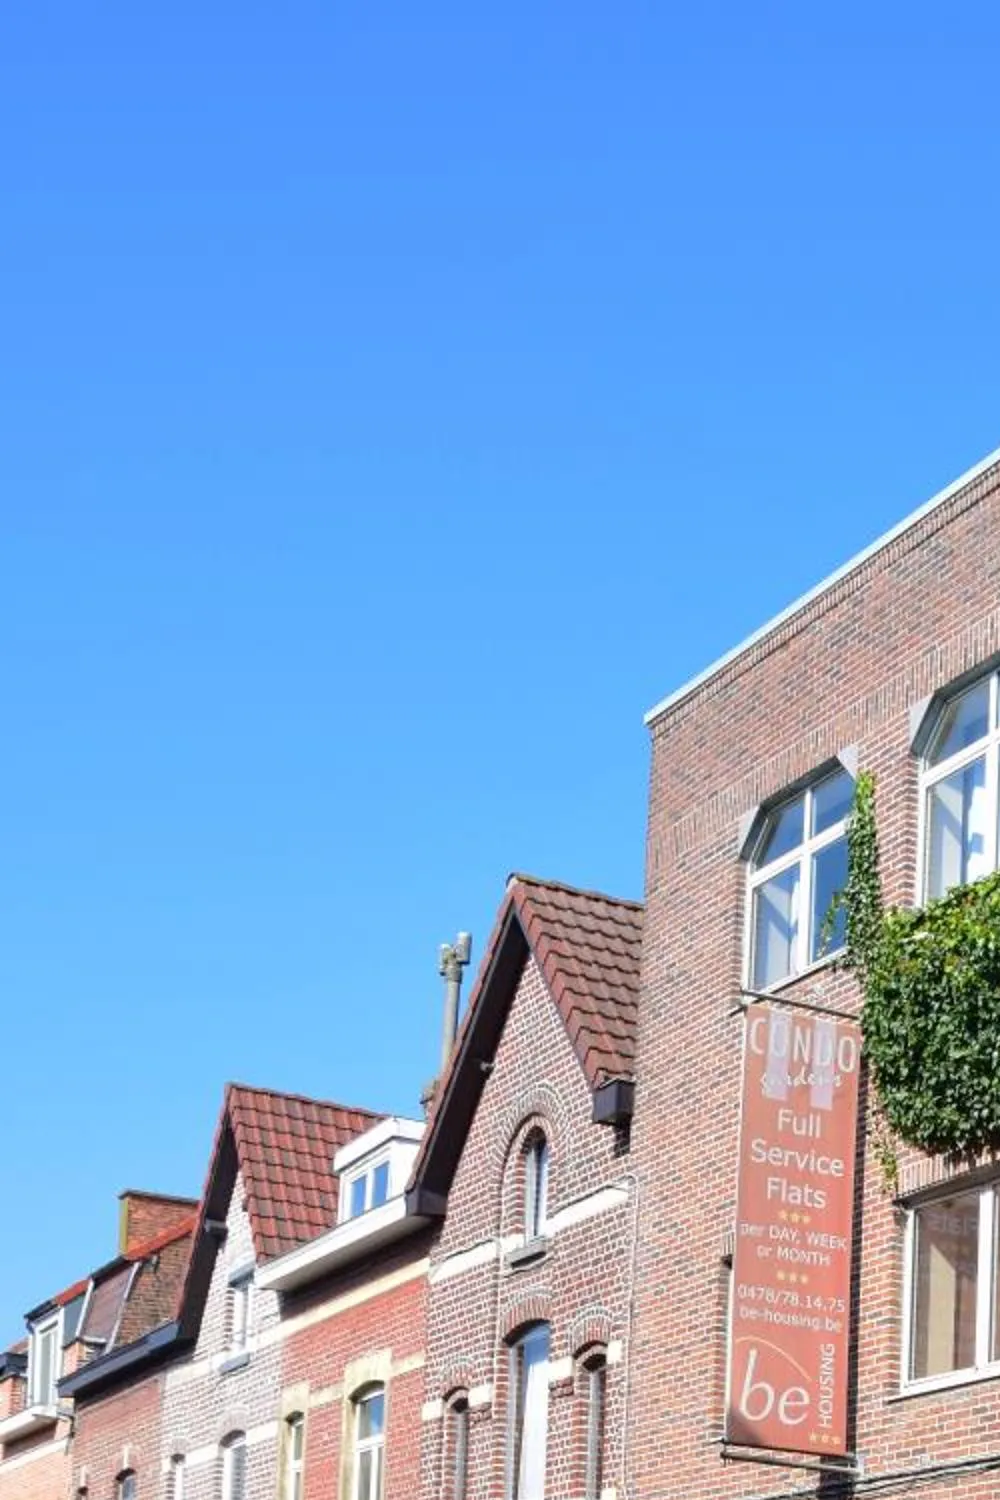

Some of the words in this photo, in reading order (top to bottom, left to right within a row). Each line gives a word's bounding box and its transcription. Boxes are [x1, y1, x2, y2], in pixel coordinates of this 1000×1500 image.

[749, 1017, 857, 1073] CONDO
[777, 1107, 822, 1139] Full
[750, 1137, 845, 1178] Service
[766, 1176, 827, 1209] Flats
[769, 1224, 801, 1245] DAY,
[804, 1231, 848, 1253] WEEK
[777, 1245, 831, 1267] MONTH
[740, 1347, 811, 1426] be
[818, 1343, 836, 1429] HOUSING
